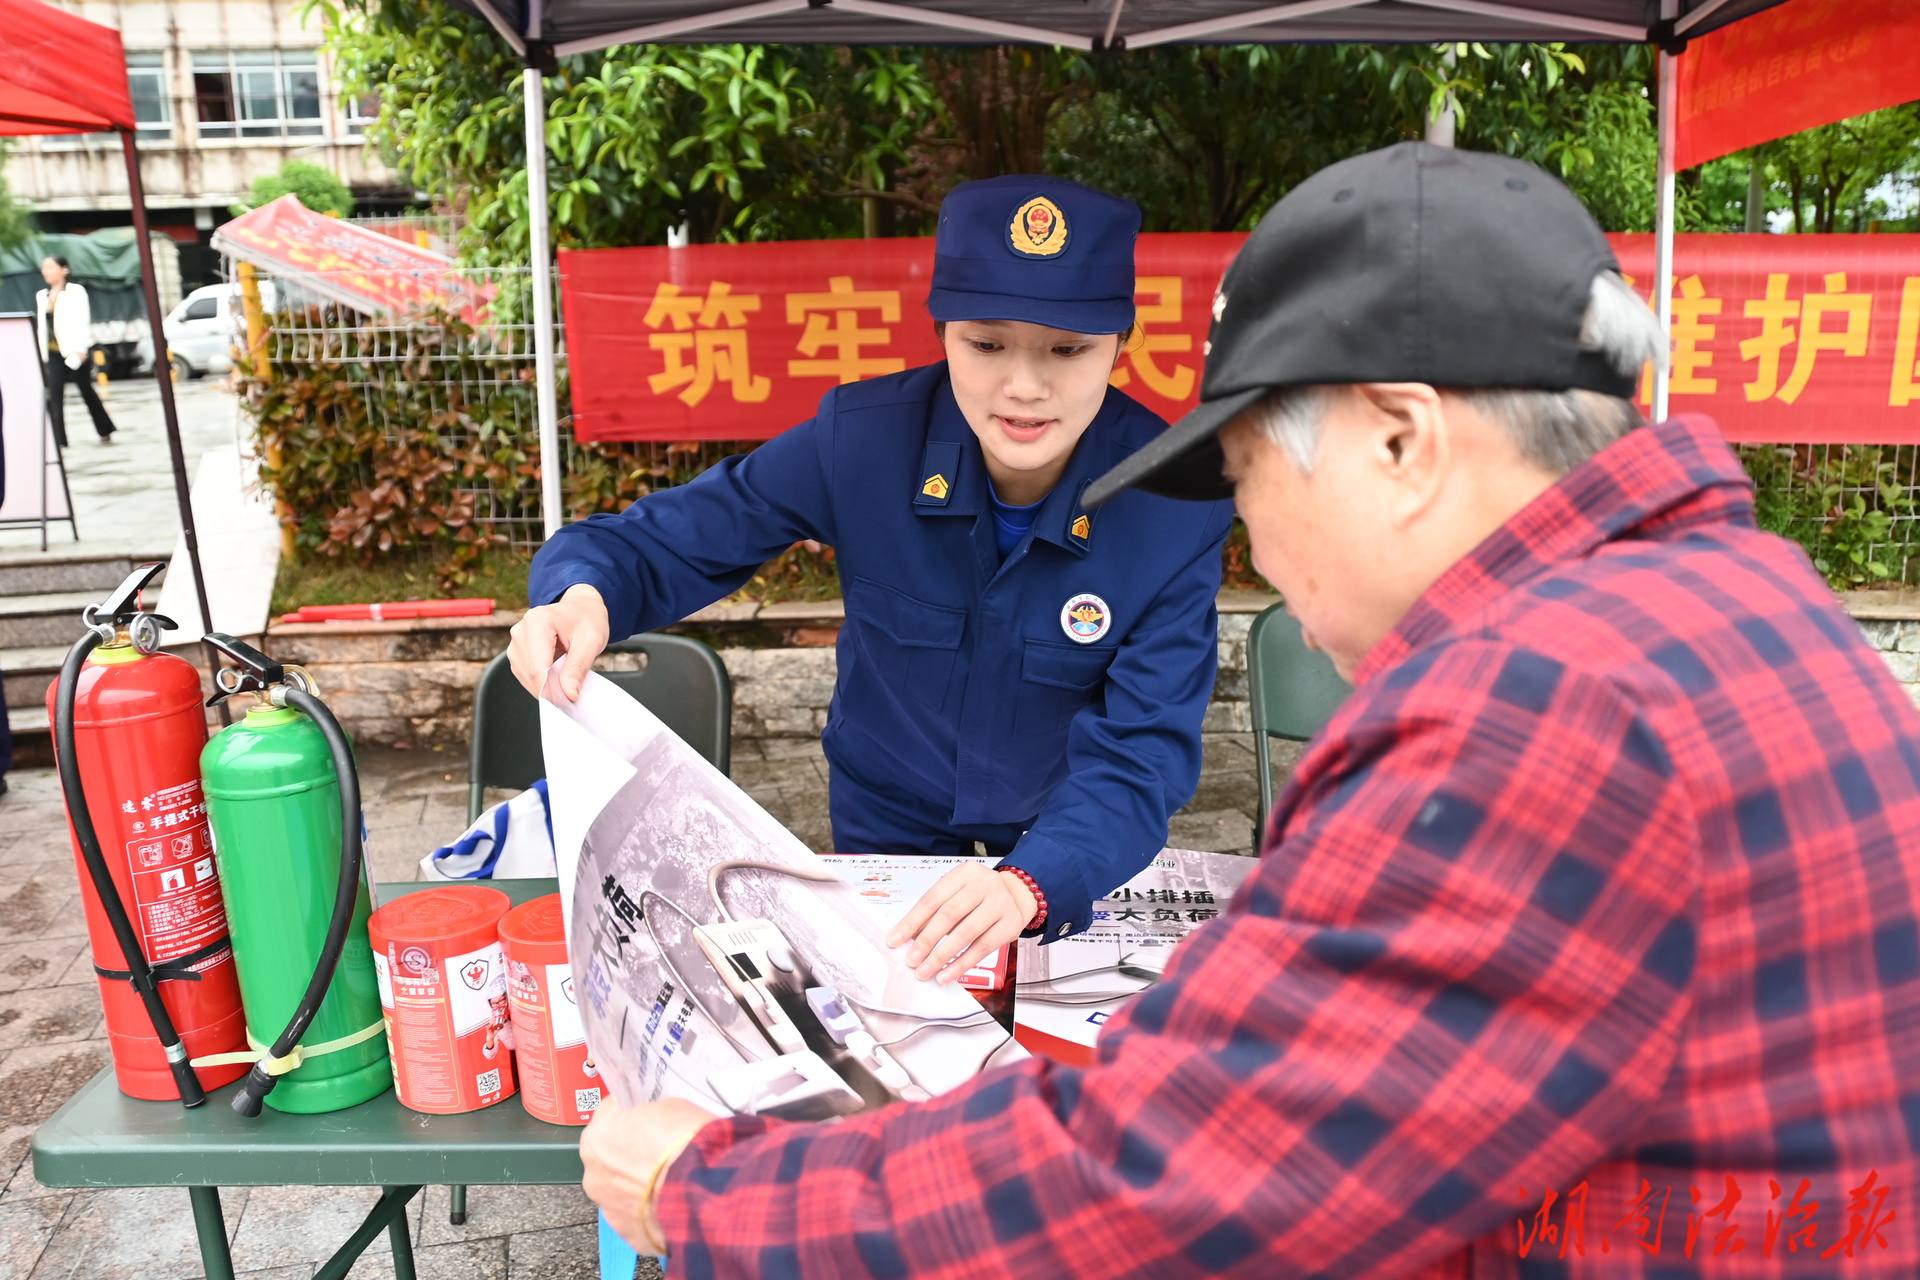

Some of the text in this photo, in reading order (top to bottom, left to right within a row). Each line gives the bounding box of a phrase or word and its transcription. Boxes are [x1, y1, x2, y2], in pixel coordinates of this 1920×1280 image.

[643, 276, 906, 407] 筑牢
[1100, 887, 1215, 904] 小排插
